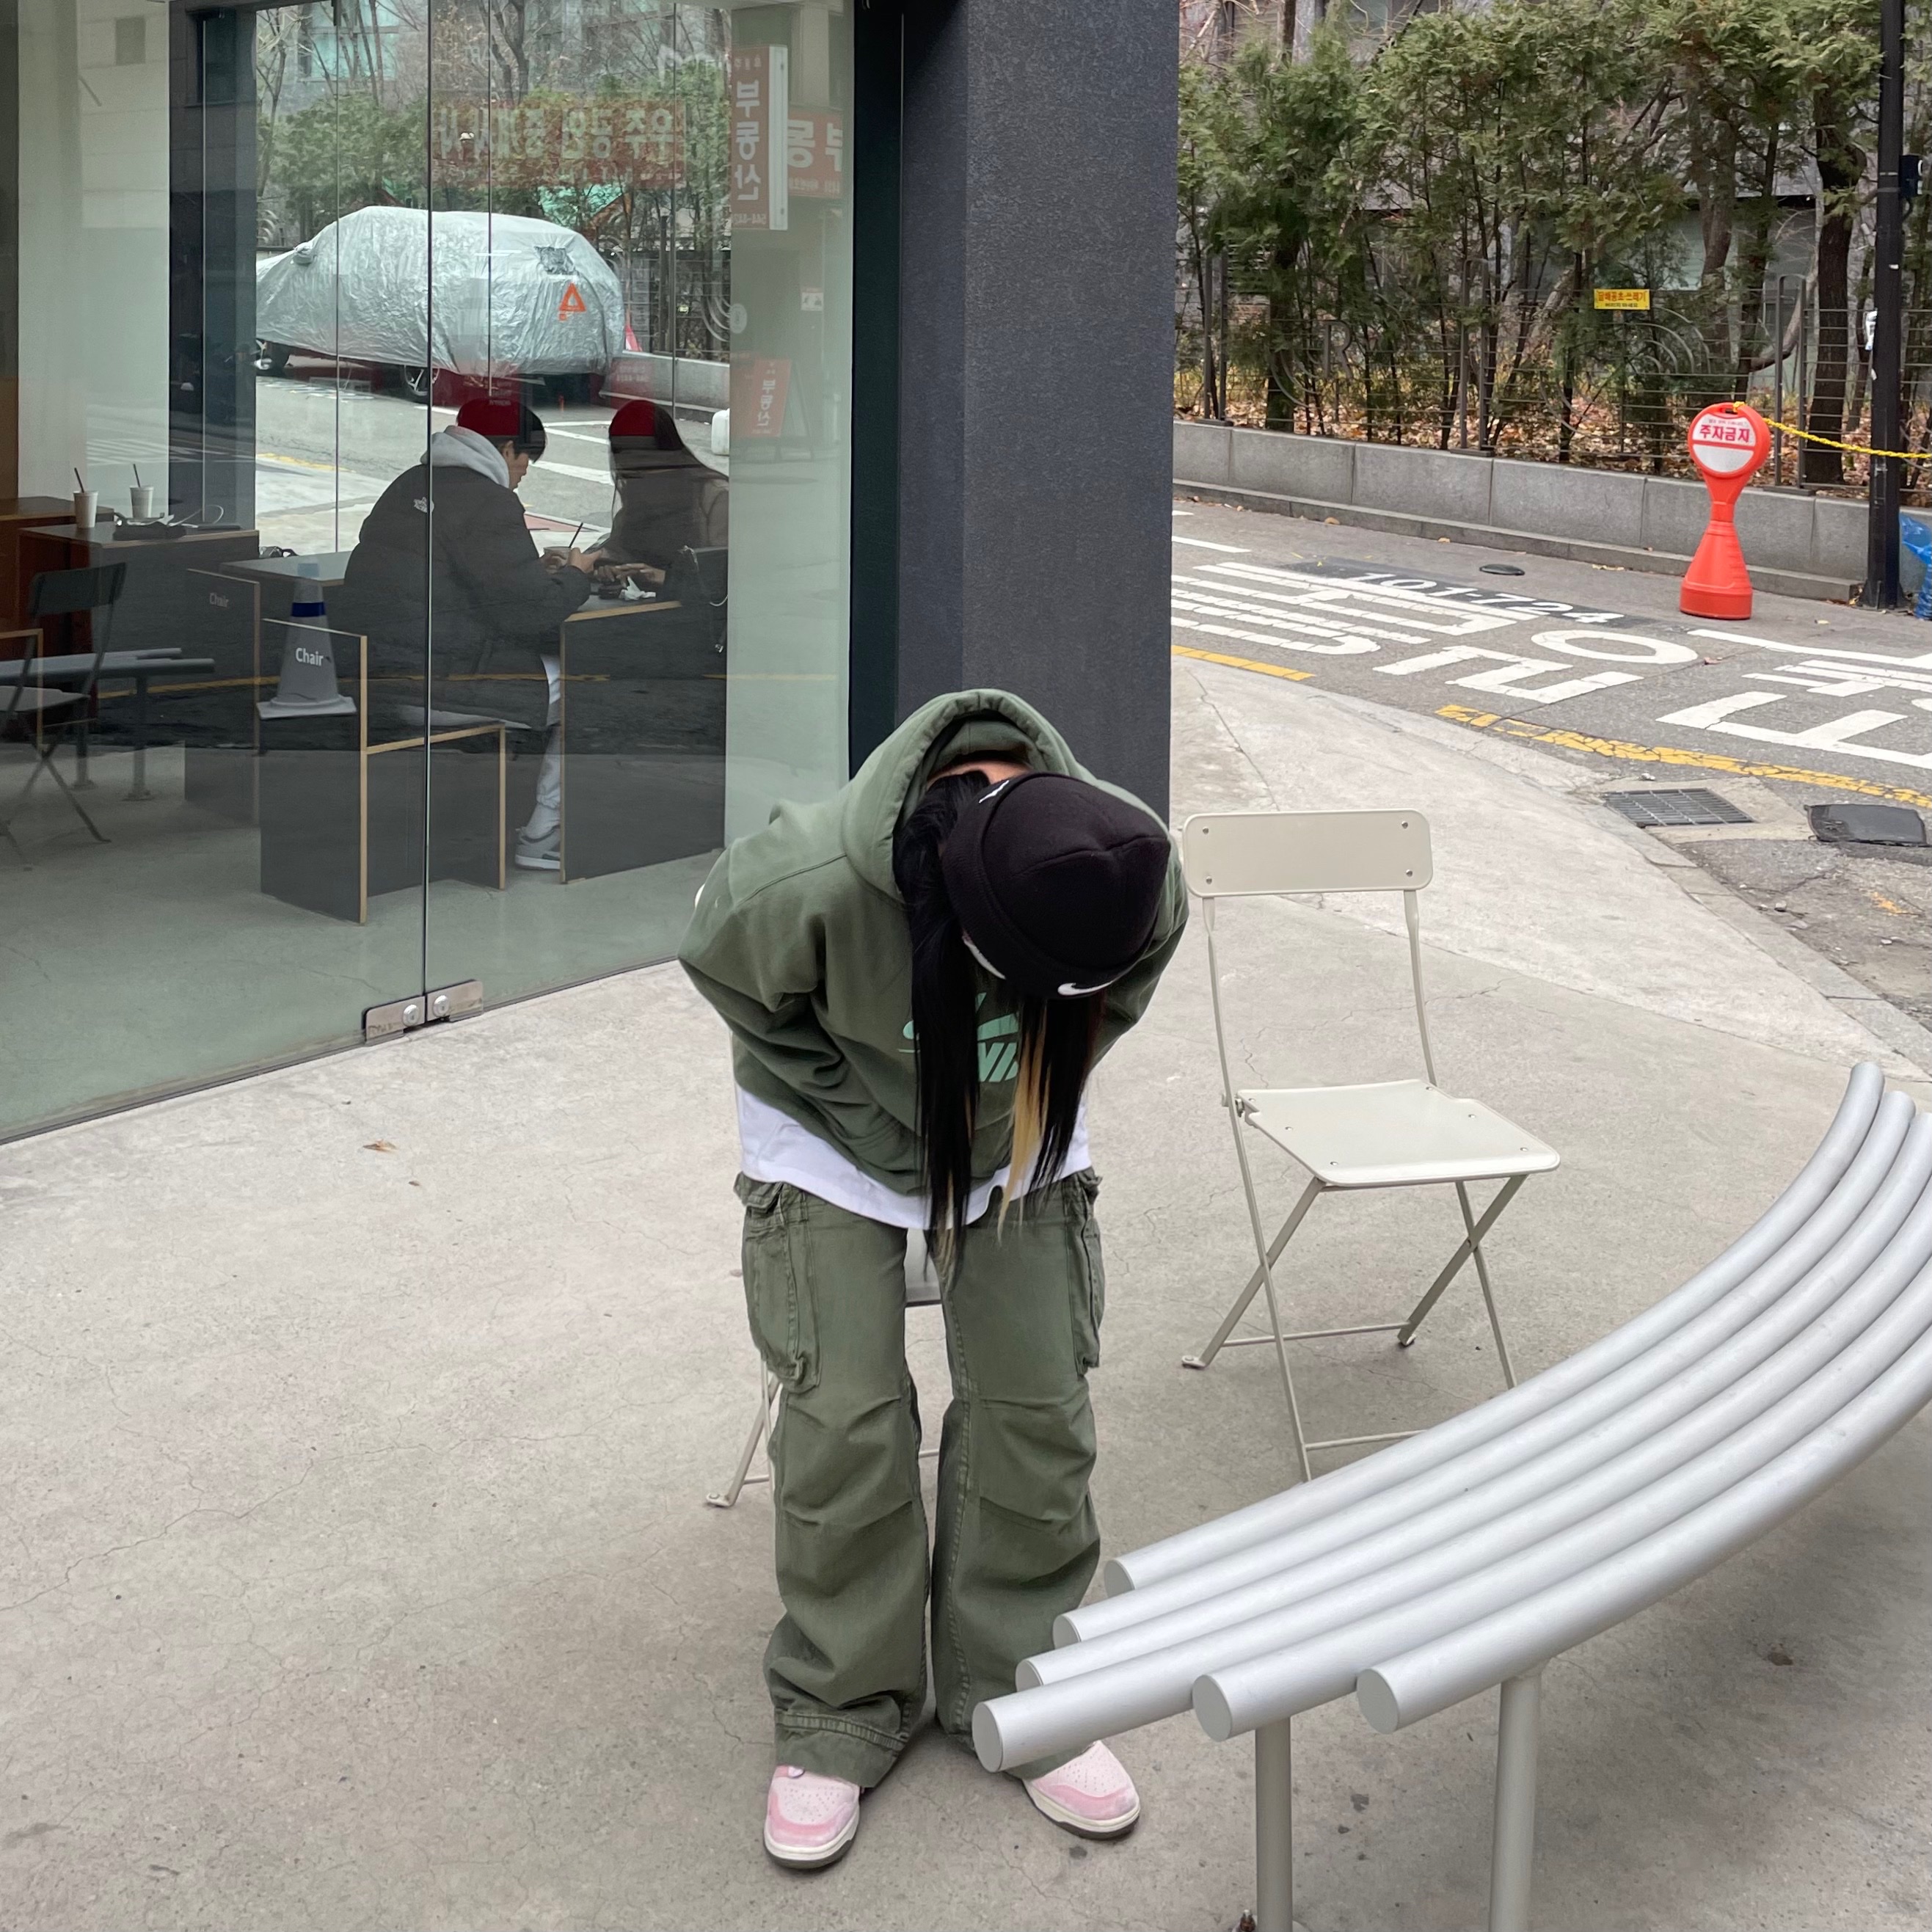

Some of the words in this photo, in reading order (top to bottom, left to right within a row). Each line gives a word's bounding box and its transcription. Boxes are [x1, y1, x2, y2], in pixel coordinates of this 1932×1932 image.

[209, 592, 229, 608] Chair
[1349, 572, 1625, 624] 101-724
[295, 647, 324, 667] Chair
